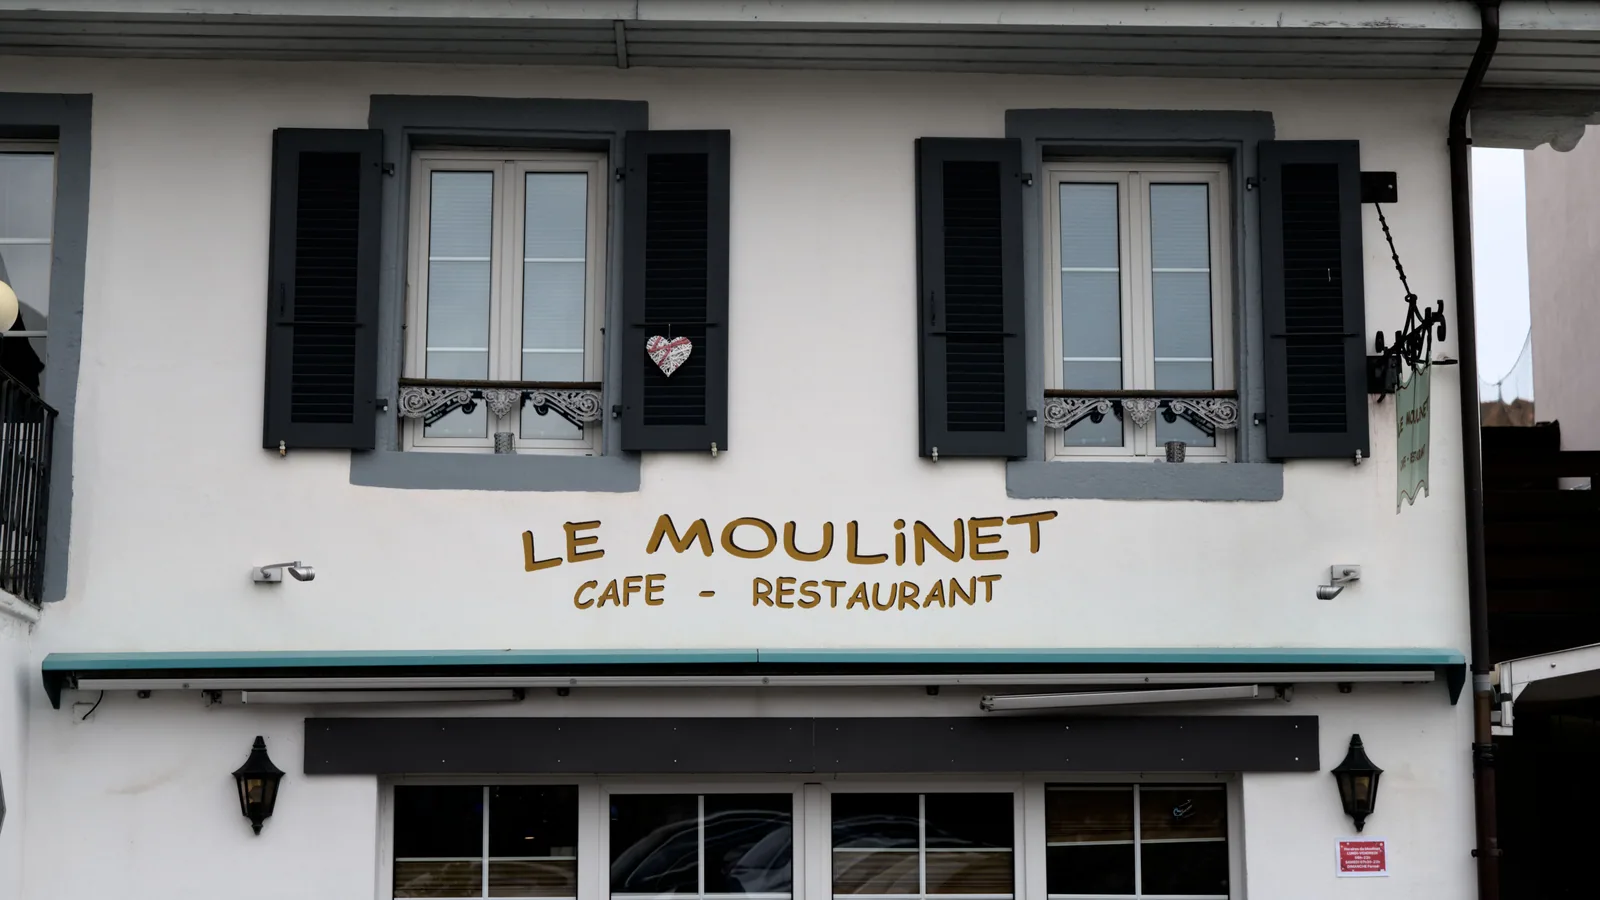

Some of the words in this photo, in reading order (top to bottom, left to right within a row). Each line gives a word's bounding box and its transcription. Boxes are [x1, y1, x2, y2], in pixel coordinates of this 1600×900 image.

[522, 520, 606, 573] LE
[573, 573, 667, 610] CAFE
[752, 573, 1003, 612] RESTAURANT
